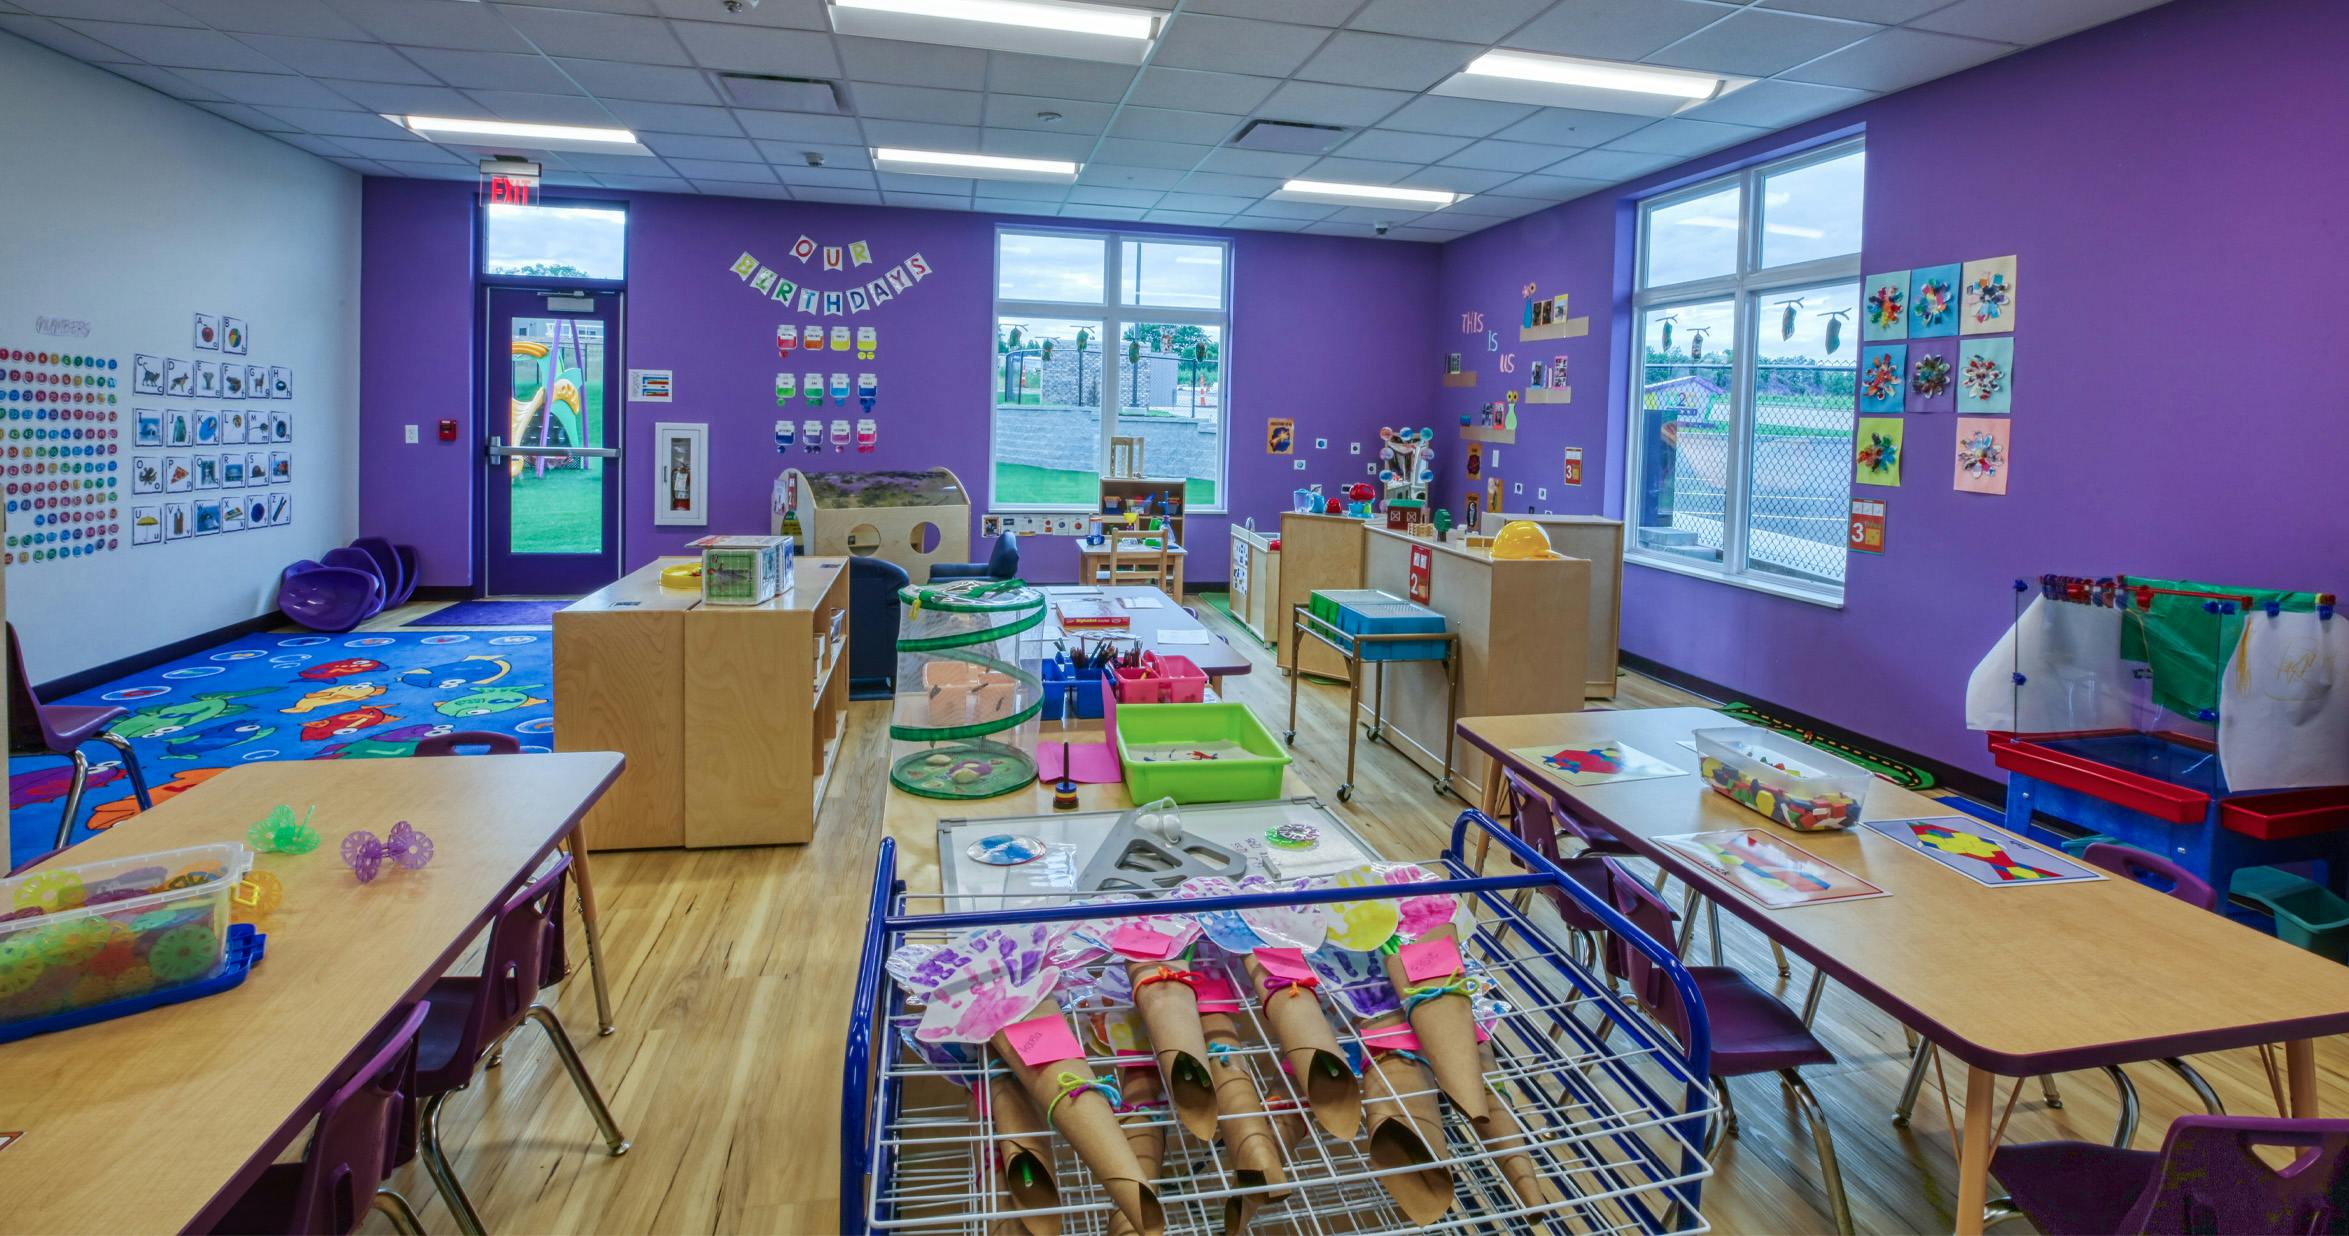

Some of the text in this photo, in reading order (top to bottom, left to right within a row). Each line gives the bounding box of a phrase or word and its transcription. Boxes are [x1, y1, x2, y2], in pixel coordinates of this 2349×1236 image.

[491, 176, 532, 206] EXIT
[796, 240, 868, 266] OUR
[735, 255, 926, 312] BIRTHDAYS
[1461, 311, 1485, 335] THIS
[1487, 330, 1498, 352] IS
[1500, 353, 1516, 373] US
[1566, 464, 1572, 479] 3
[1851, 522, 1865, 543] 3
[1410, 572, 1418, 595] 2
